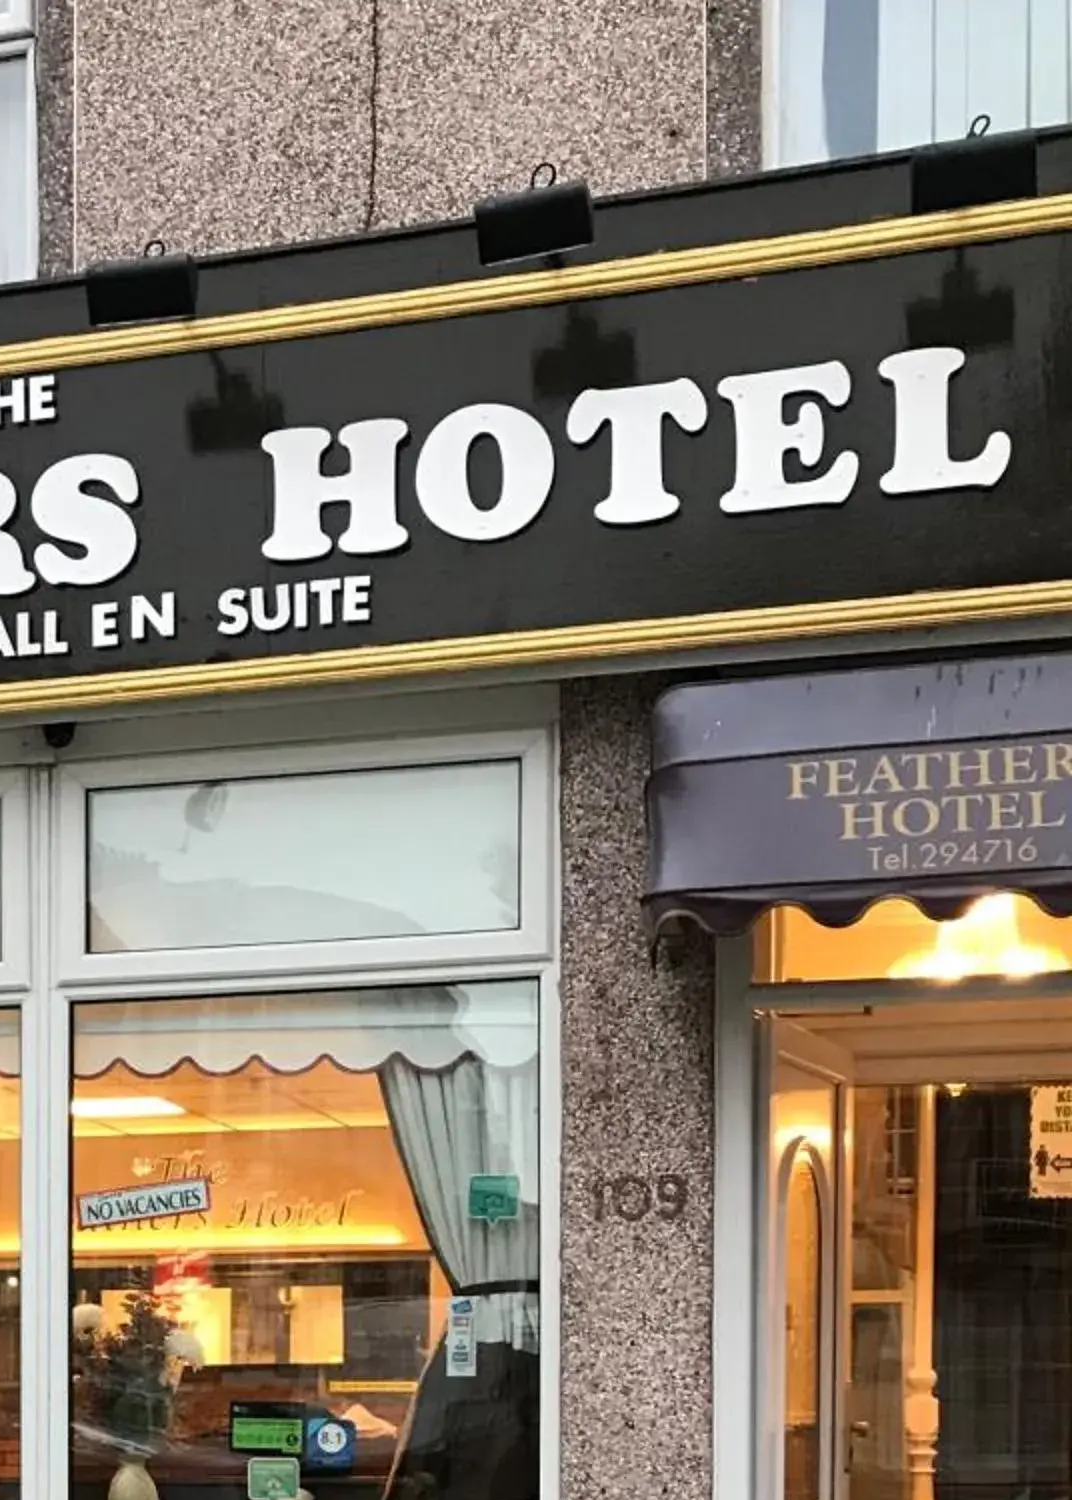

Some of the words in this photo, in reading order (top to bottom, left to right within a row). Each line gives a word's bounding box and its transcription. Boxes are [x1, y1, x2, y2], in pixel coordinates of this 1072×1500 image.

[261, 347, 1011, 561] HOTEL
[91, 591, 176, 648] EN
[217, 575, 372, 636] SUITE
[839, 789, 1066, 840] HOTEL
[1055, 1105, 1072, 1118] YO
[87, 1201, 114, 1221] NO
[115, 1187, 202, 1217] VACANCIES
[591, 1174, 689, 1221] 109
